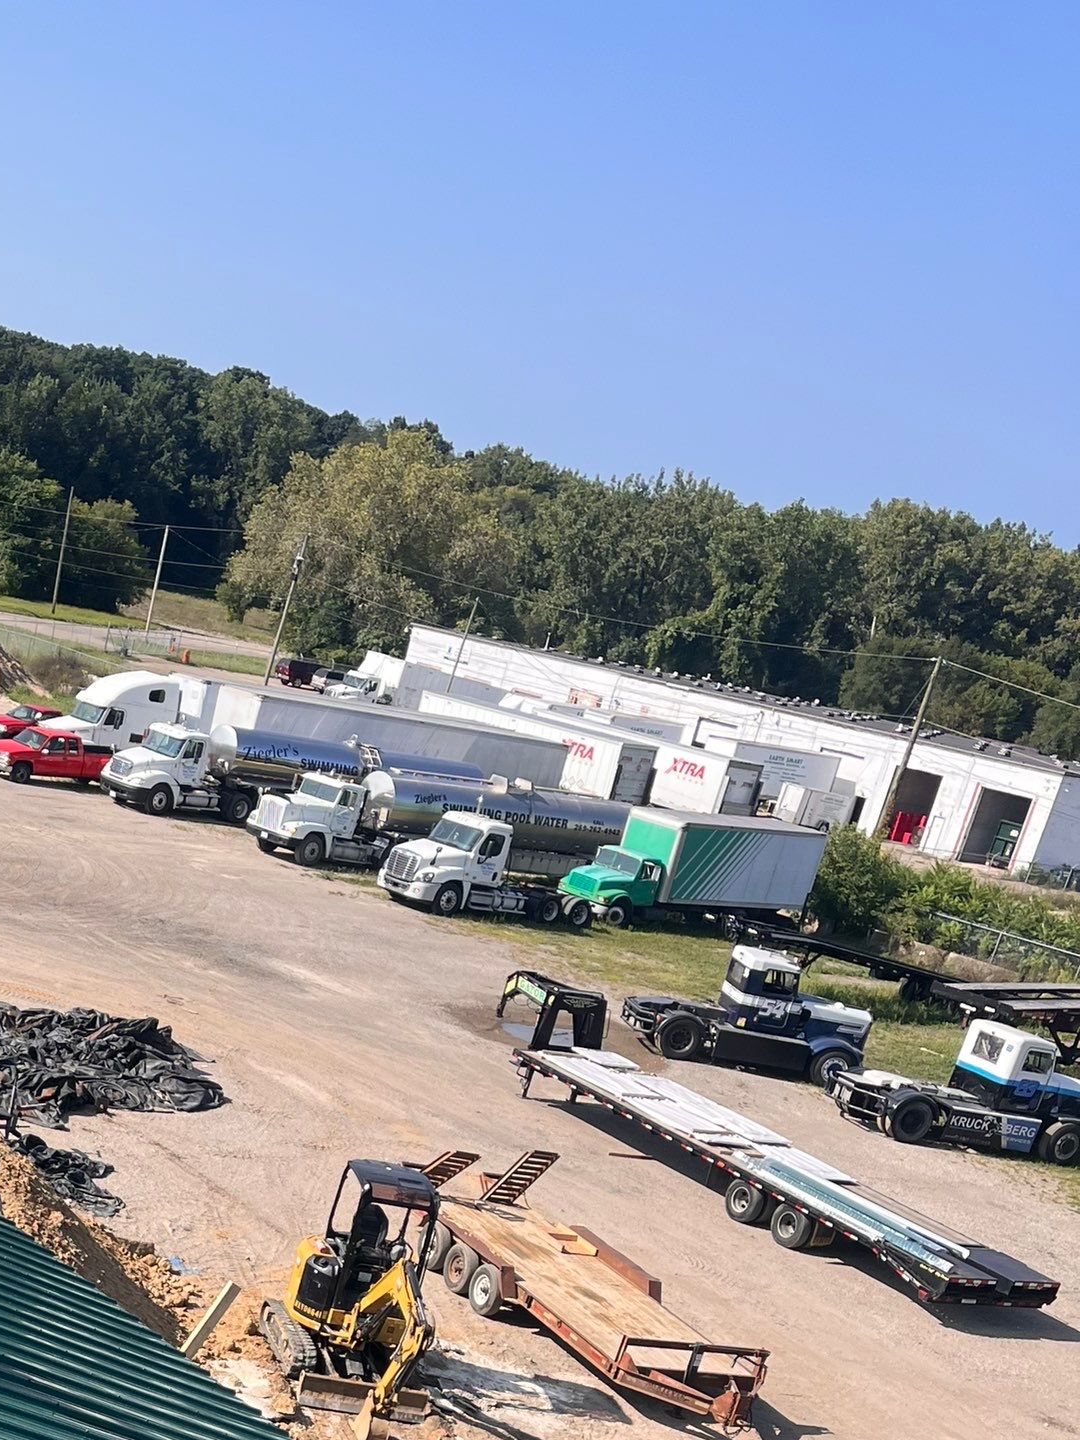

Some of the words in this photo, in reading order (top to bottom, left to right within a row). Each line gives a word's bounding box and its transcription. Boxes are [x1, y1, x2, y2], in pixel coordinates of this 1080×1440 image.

[242, 743, 299, 763] Ziegler's
[665, 757, 706, 779] XTRA
[504, 810, 532, 825] POOL
[534, 815, 569, 829] WATER
[950, 1115, 991, 1131] KRUCK
[1006, 1124, 1037, 1138] BERG
